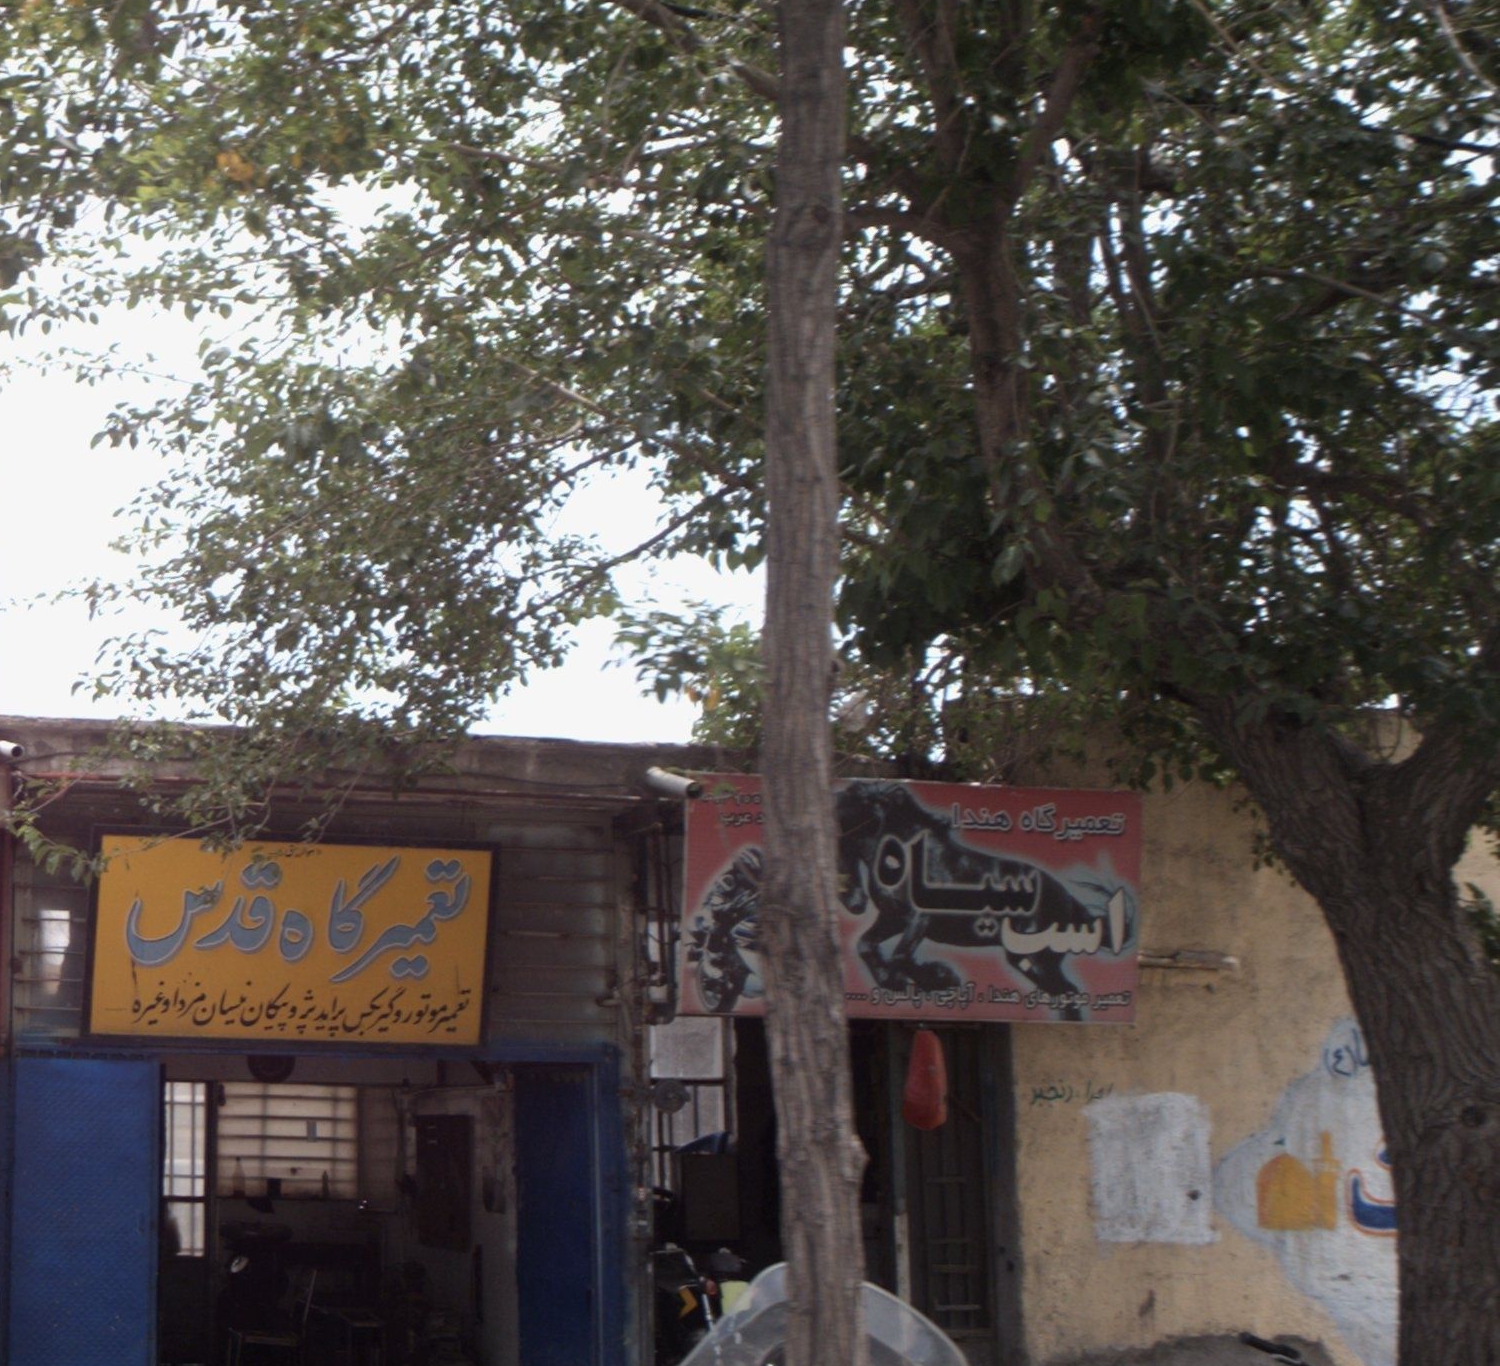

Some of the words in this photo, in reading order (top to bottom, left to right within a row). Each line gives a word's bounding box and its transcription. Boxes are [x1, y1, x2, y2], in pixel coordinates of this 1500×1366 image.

[950, 802, 1013, 832] هندا
[1018, 802, 1125, 841] تعمیرگاه
[874, 827, 1041, 937] سیاه
[125, 860, 282, 966] قدس
[1001, 886, 1125, 972] اسب
[132, 980, 166, 1025] غیره
[426, 988, 472, 1033] تعمیر
[986, 985, 1021, 1005] هندا
[1092, 990, 1132, 1010] تعمیر
